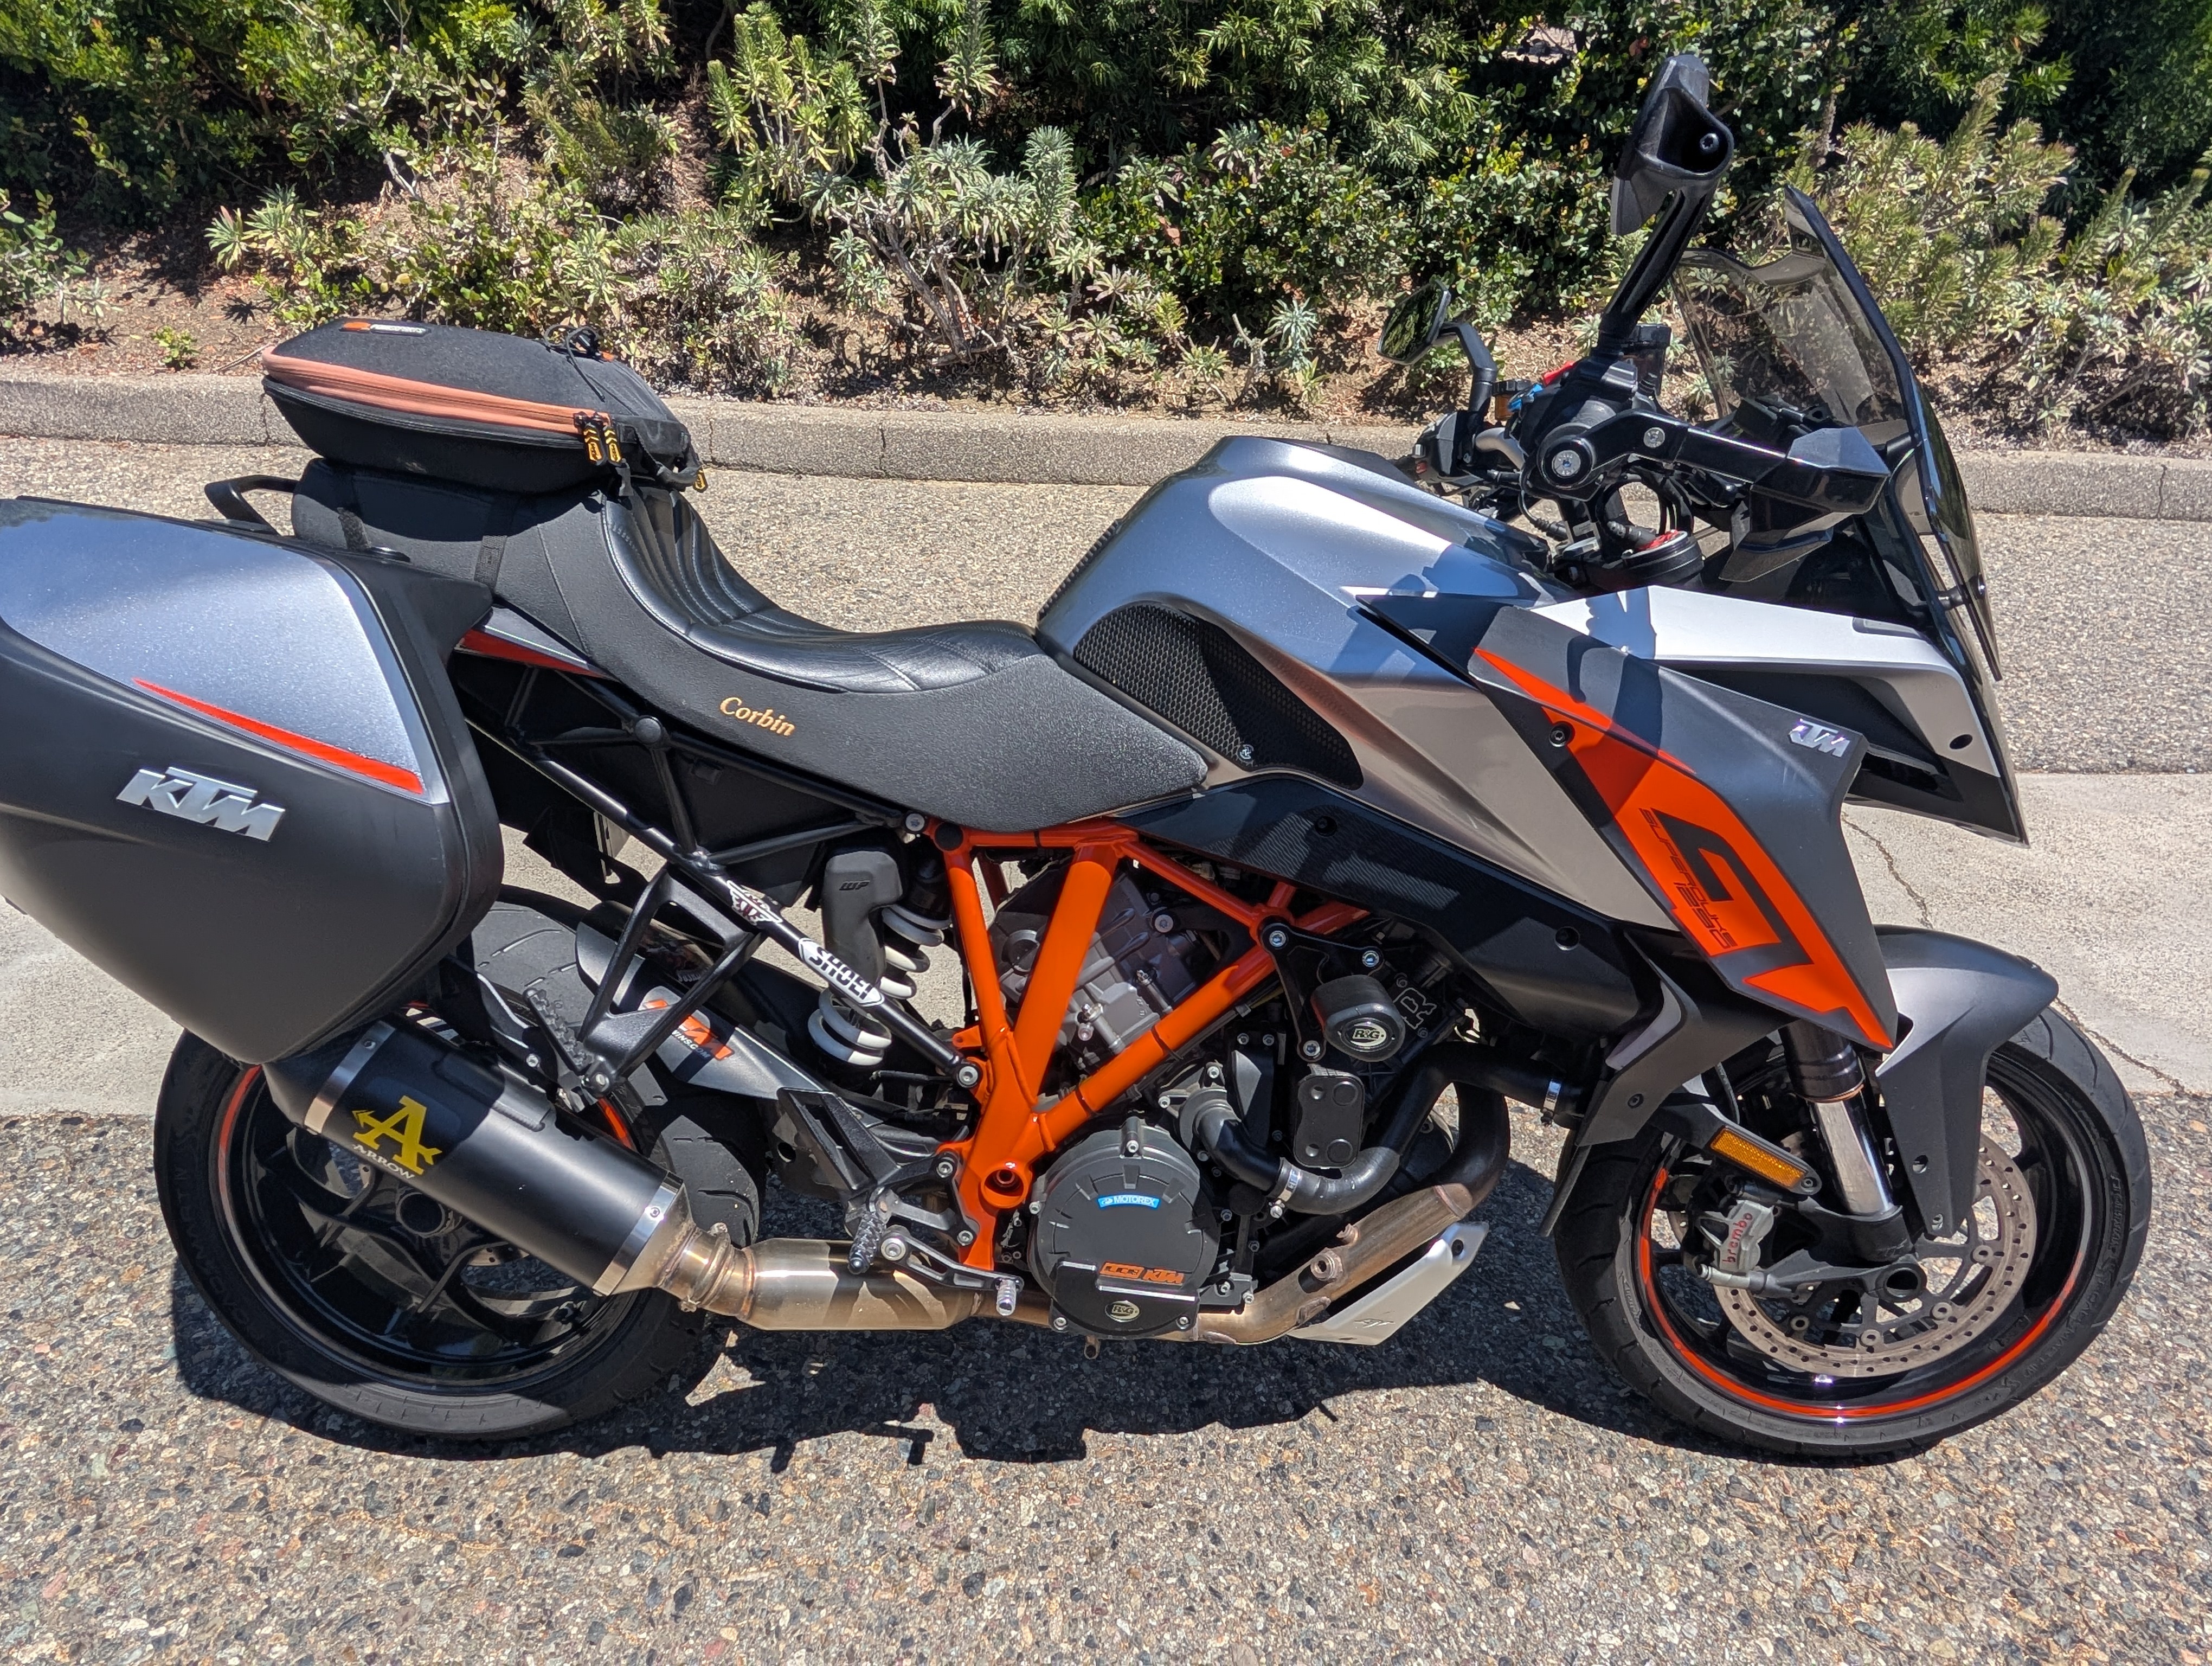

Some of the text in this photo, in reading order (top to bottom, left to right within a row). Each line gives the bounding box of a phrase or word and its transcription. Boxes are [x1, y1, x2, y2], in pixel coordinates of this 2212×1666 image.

[719, 696, 796, 736] Corbin
[1789, 718, 1851, 758] KTM
[116, 766, 286, 842] KTM
[839, 880, 871, 892] WP
[809, 946, 874, 1000] SHOEI
[353, 1144, 416, 1180] ARROW
[1113, 1195, 1155, 1206] MOTOREX
[1722, 1212, 1753, 1264] brembo
[1142, 1268, 1185, 1284] KTM
